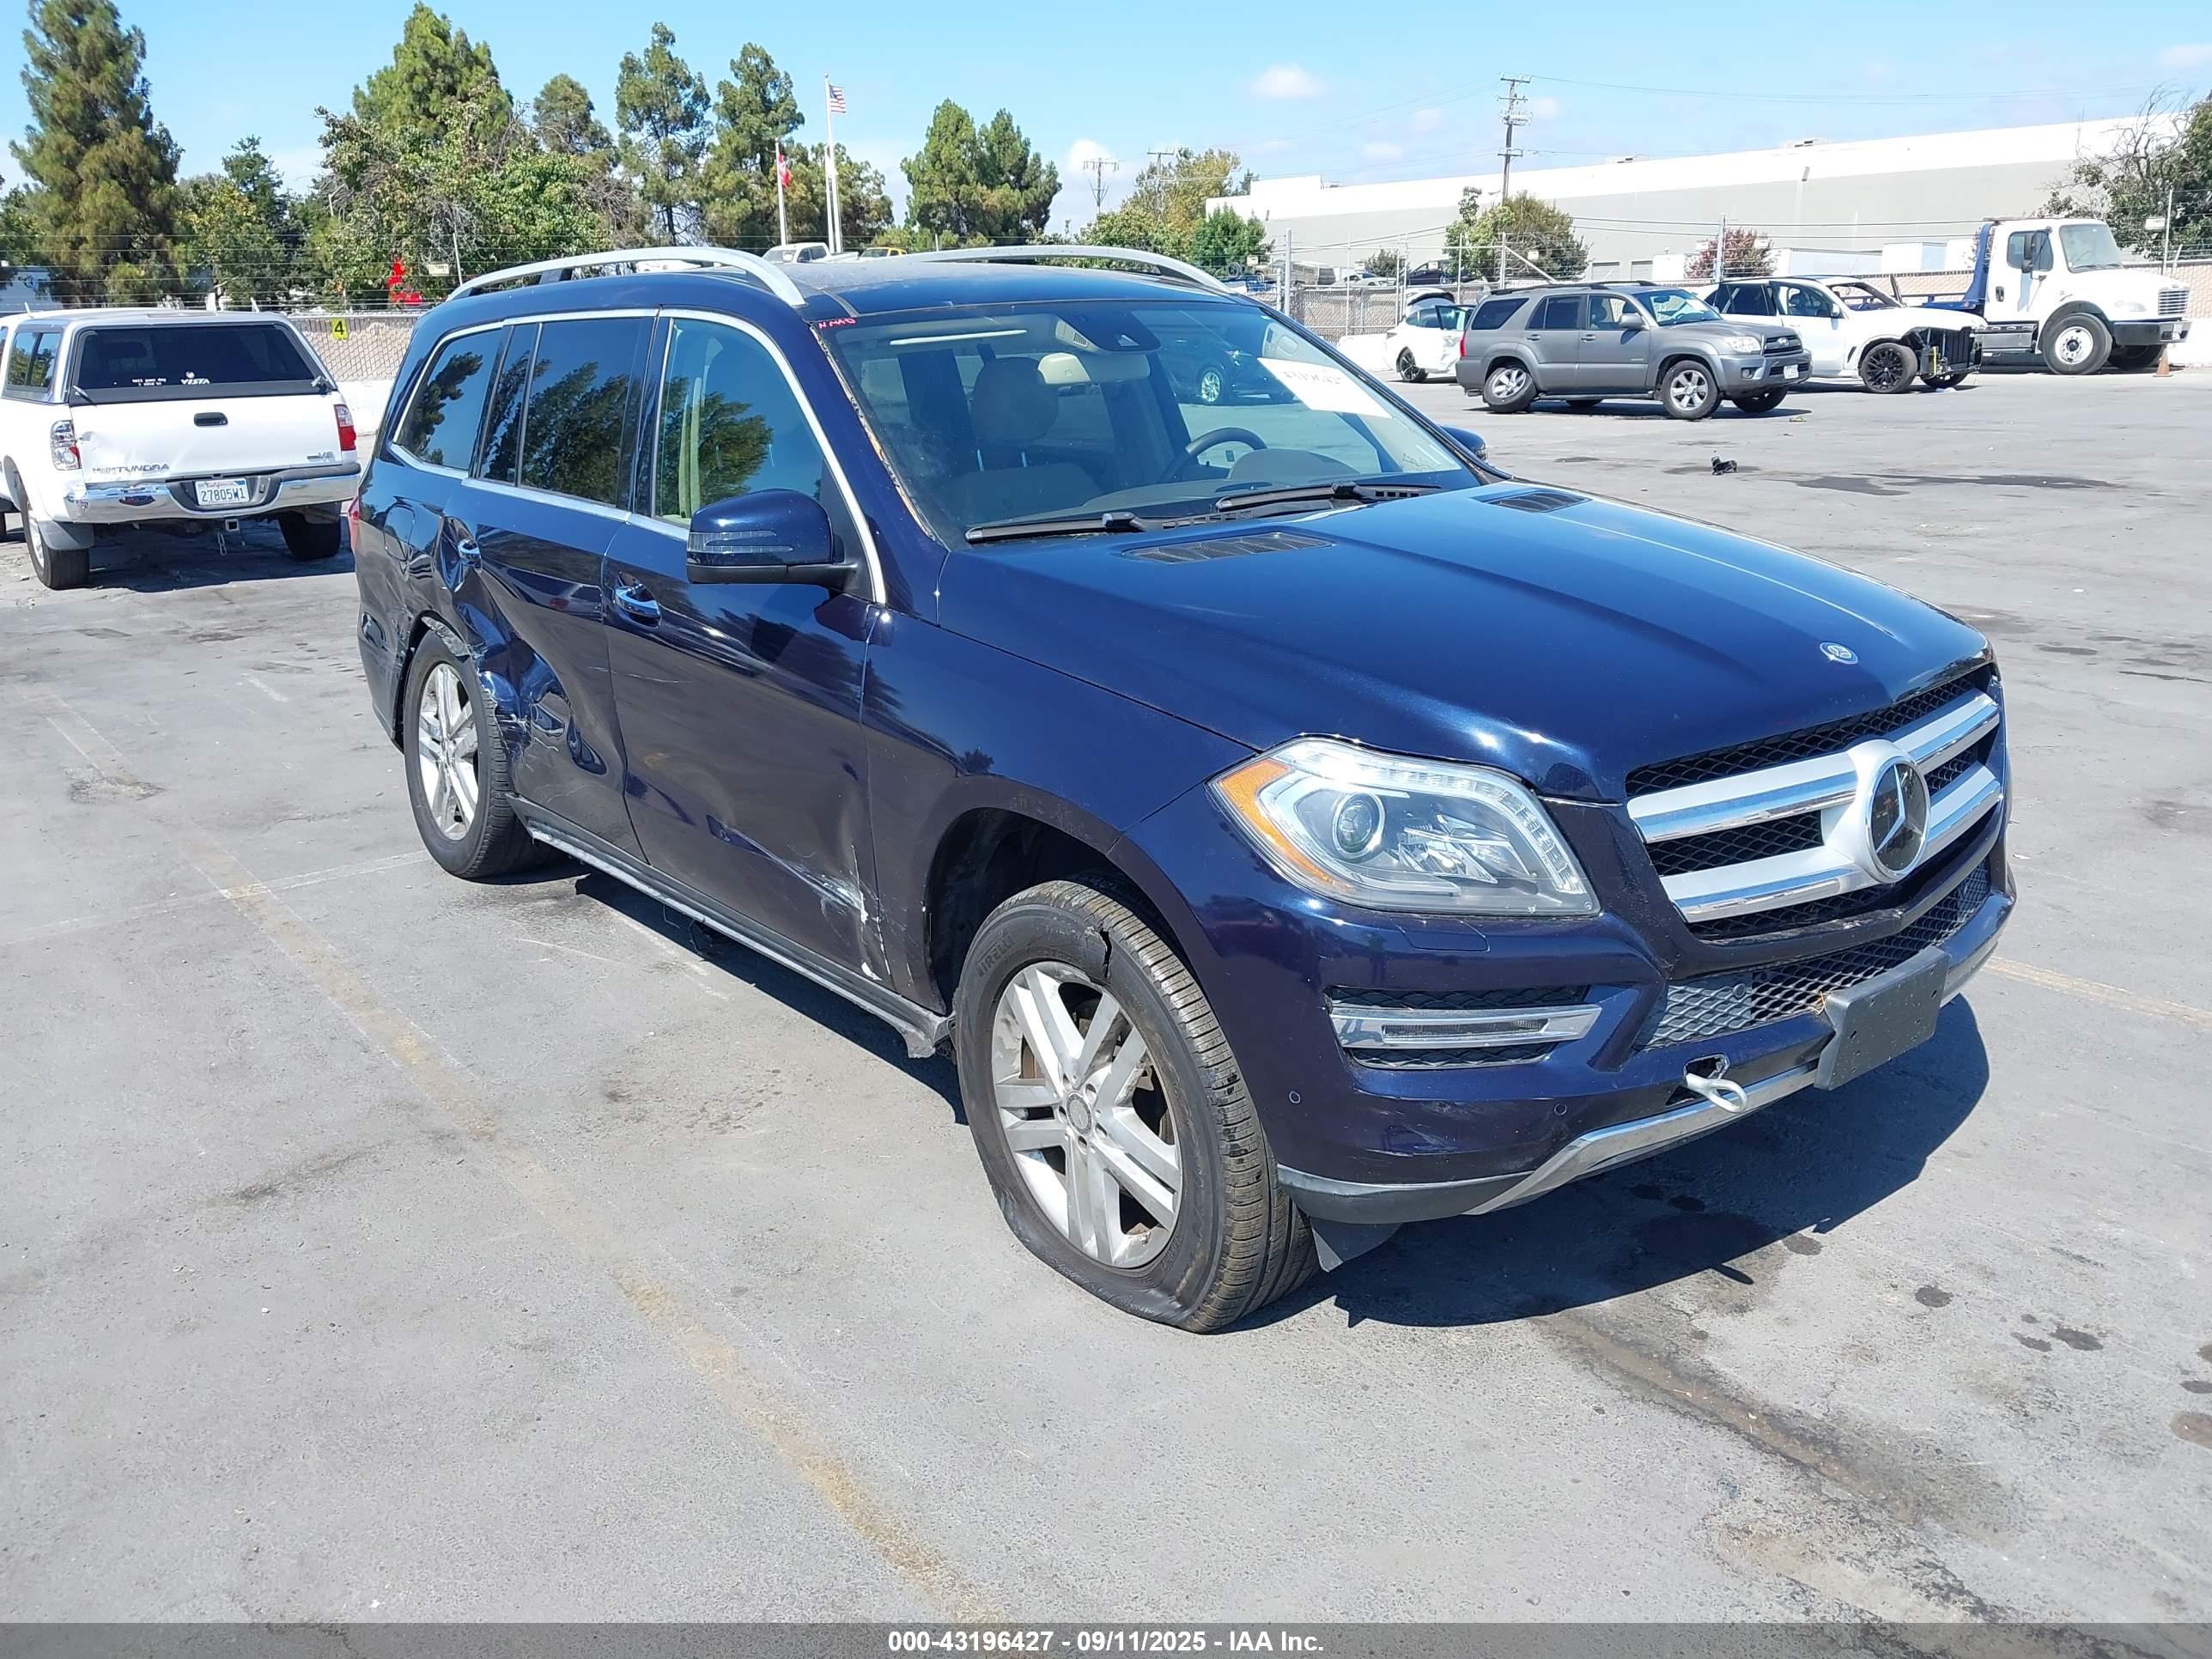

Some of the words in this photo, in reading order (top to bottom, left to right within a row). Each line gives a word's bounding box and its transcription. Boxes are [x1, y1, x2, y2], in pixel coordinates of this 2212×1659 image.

[334, 320, 344, 335] 4
[118, 463, 170, 474] TUNDRA
[200, 487, 246, 502] 27805W1
